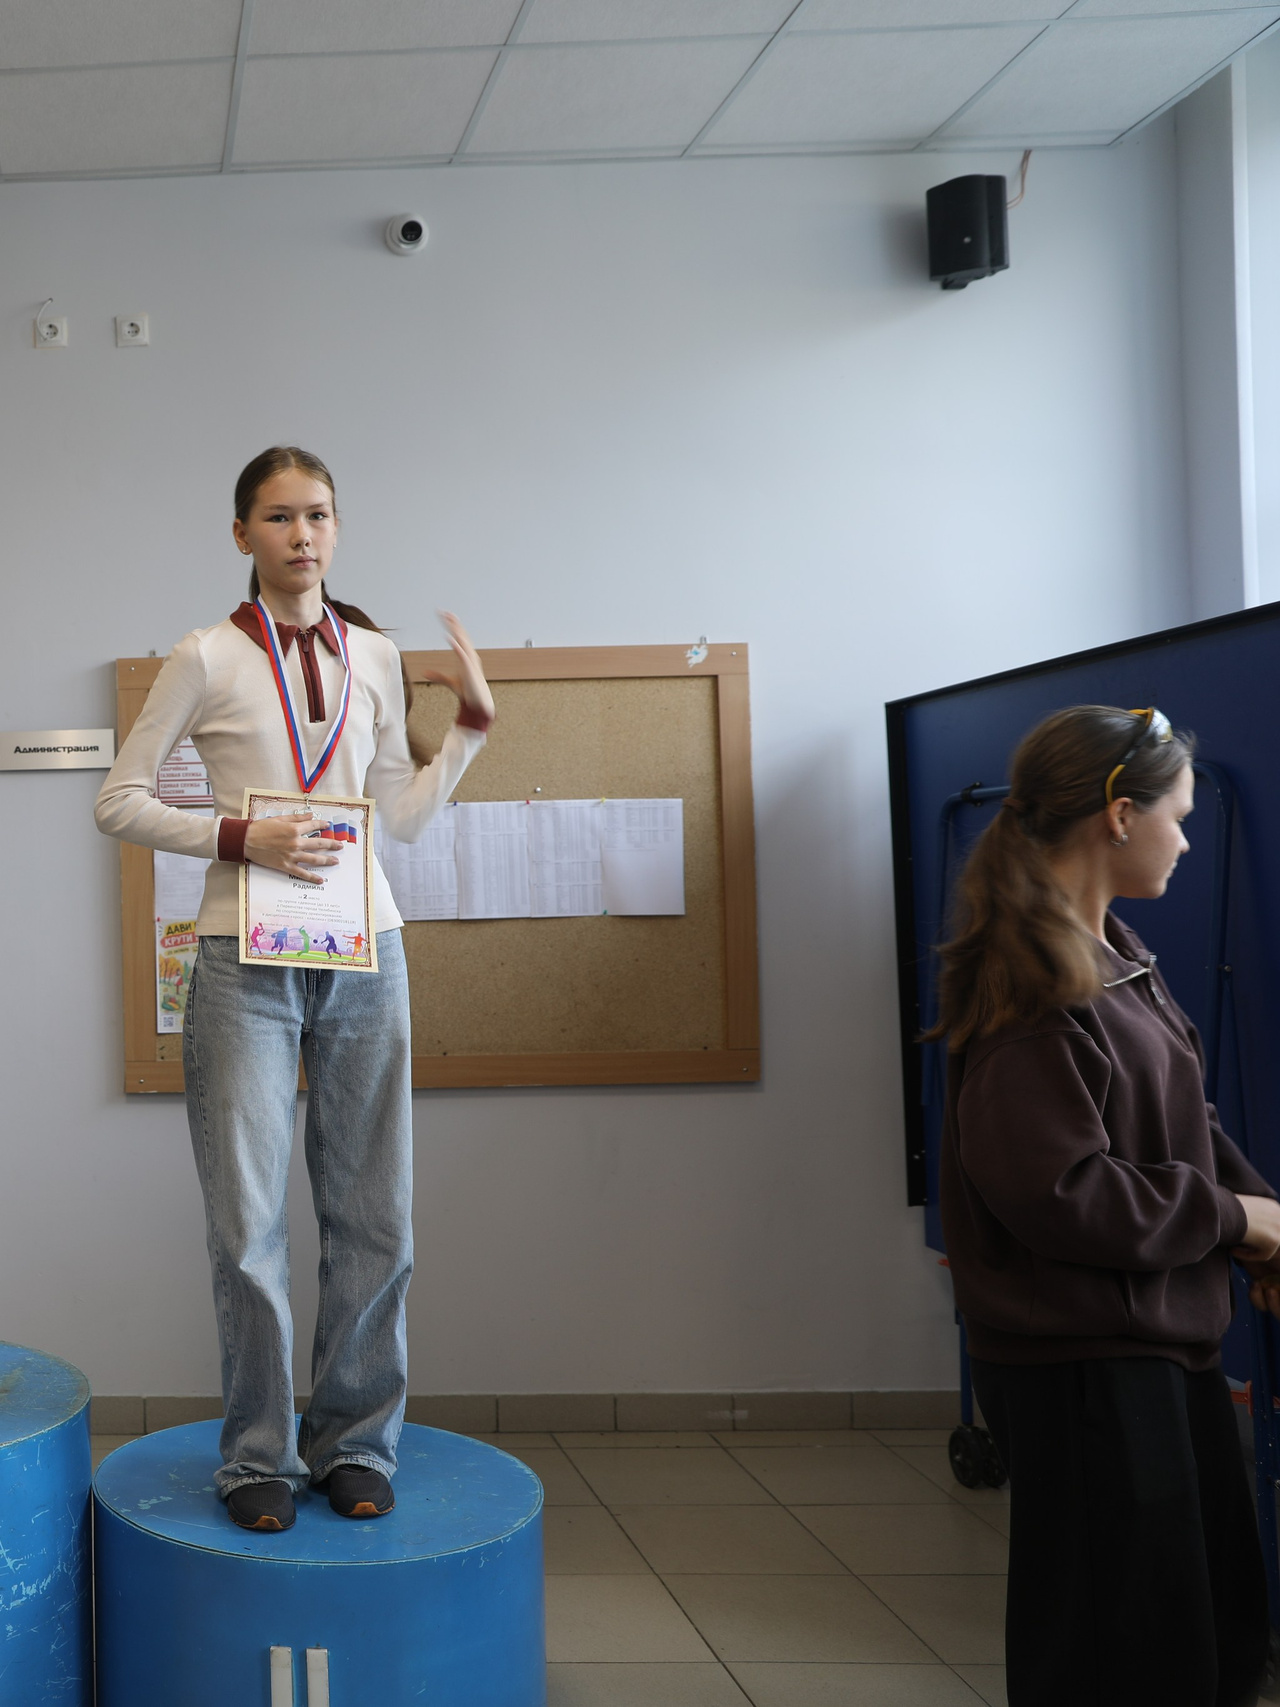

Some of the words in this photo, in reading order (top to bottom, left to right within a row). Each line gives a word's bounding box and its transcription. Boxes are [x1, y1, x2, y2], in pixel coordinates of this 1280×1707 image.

[14, 745, 99, 754] Администрация
[293, 883, 324, 891] Радмила
[166, 923, 192, 935] ДАВИ
[165, 934, 193, 947] КРУТИ
